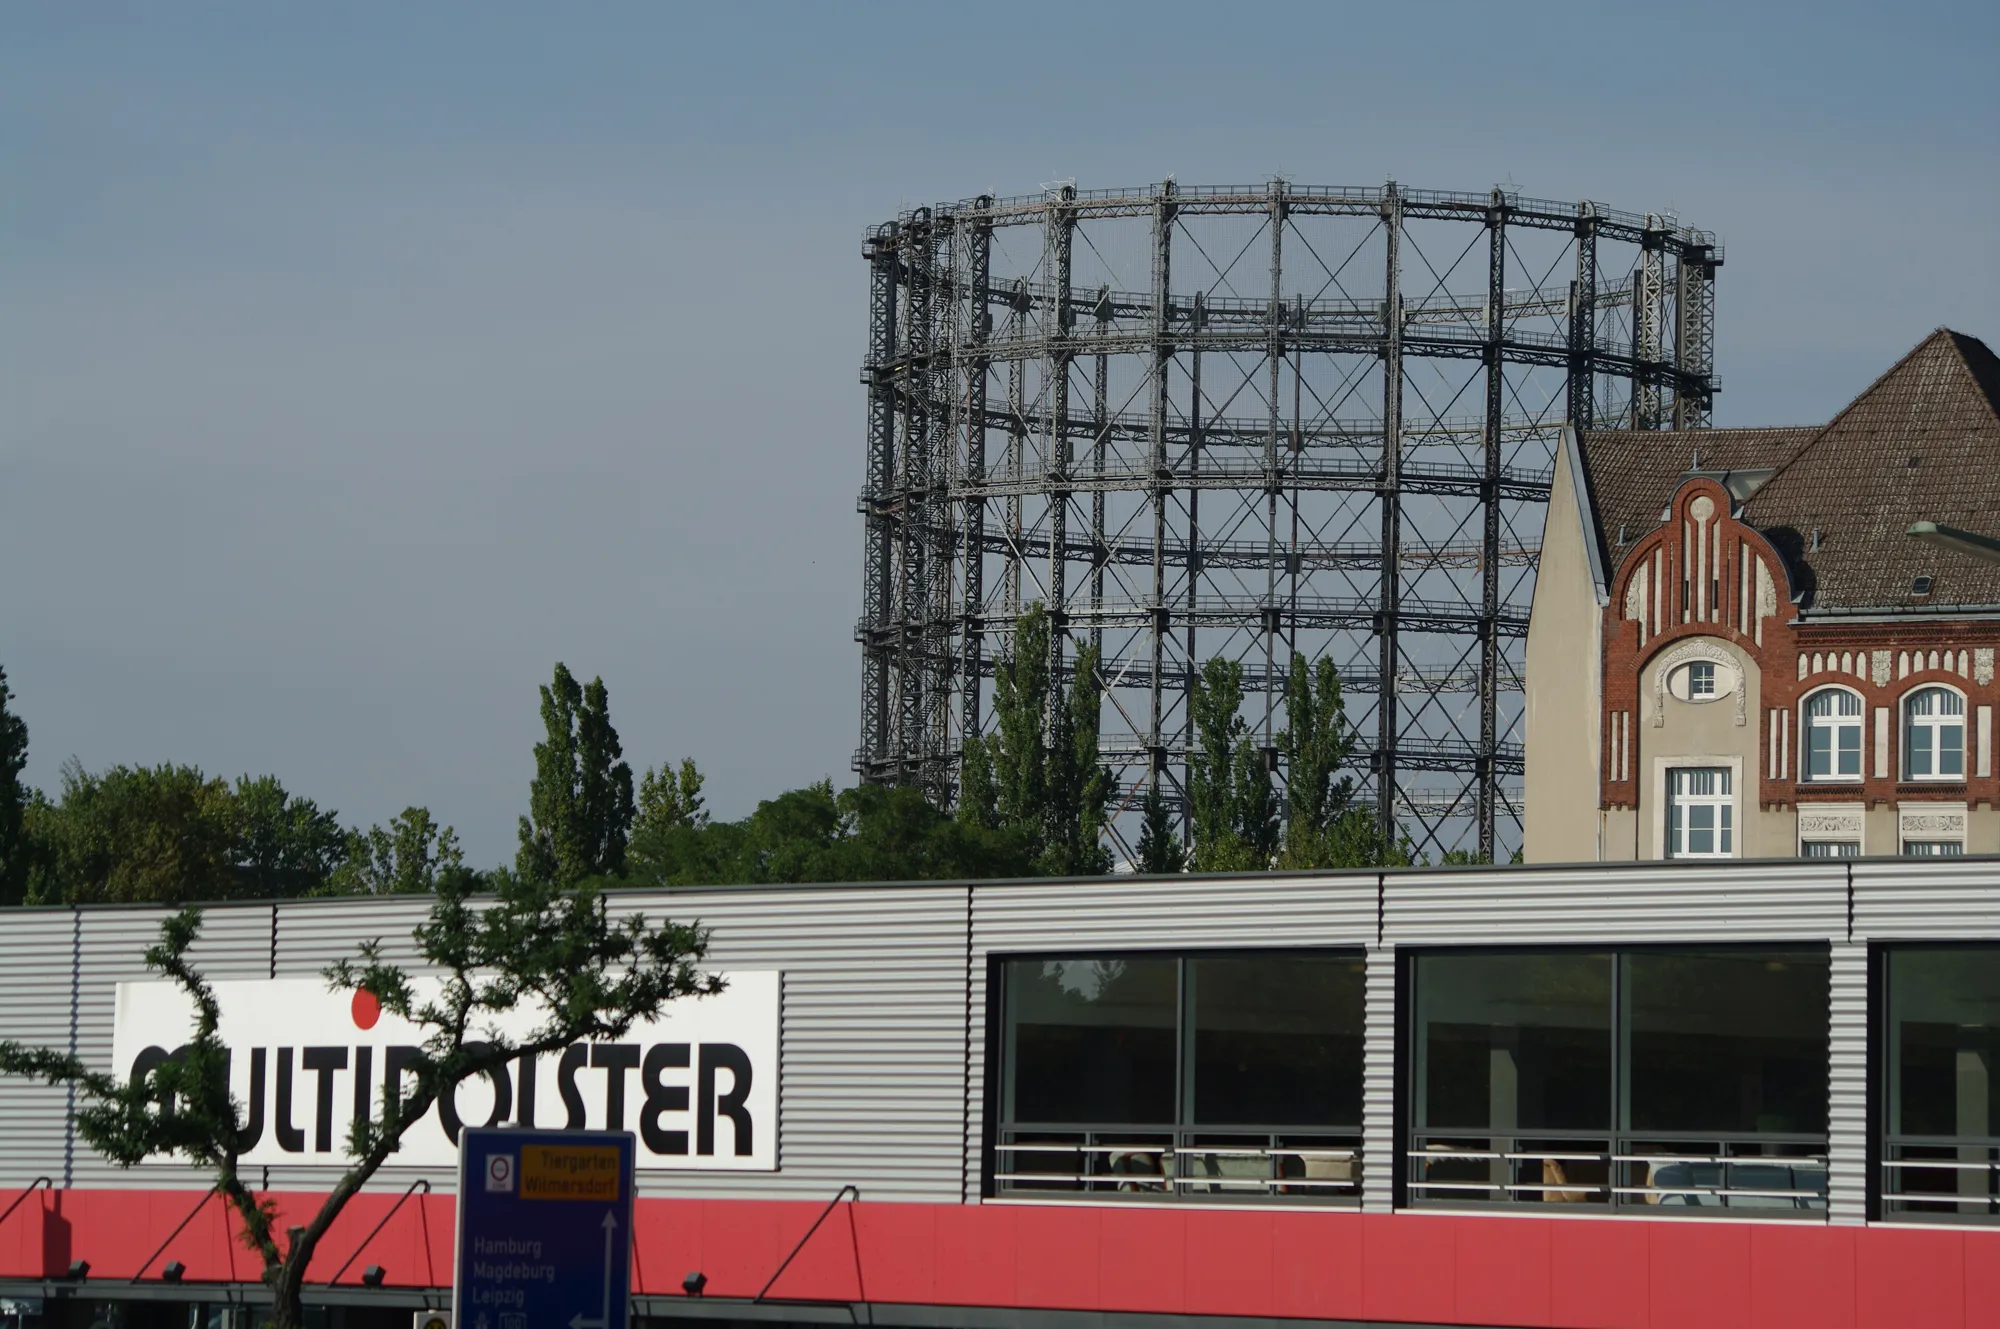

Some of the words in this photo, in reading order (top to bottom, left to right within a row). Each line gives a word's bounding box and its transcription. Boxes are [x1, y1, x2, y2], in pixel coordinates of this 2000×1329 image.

[541, 1151, 616, 1173] Tiergarten
[525, 1176, 615, 1193] Wilmersdorf
[474, 1236, 542, 1259] Hamburg
[473, 1261, 555, 1284] Magdeburg
[472, 1286, 524, 1309] Leipzig
